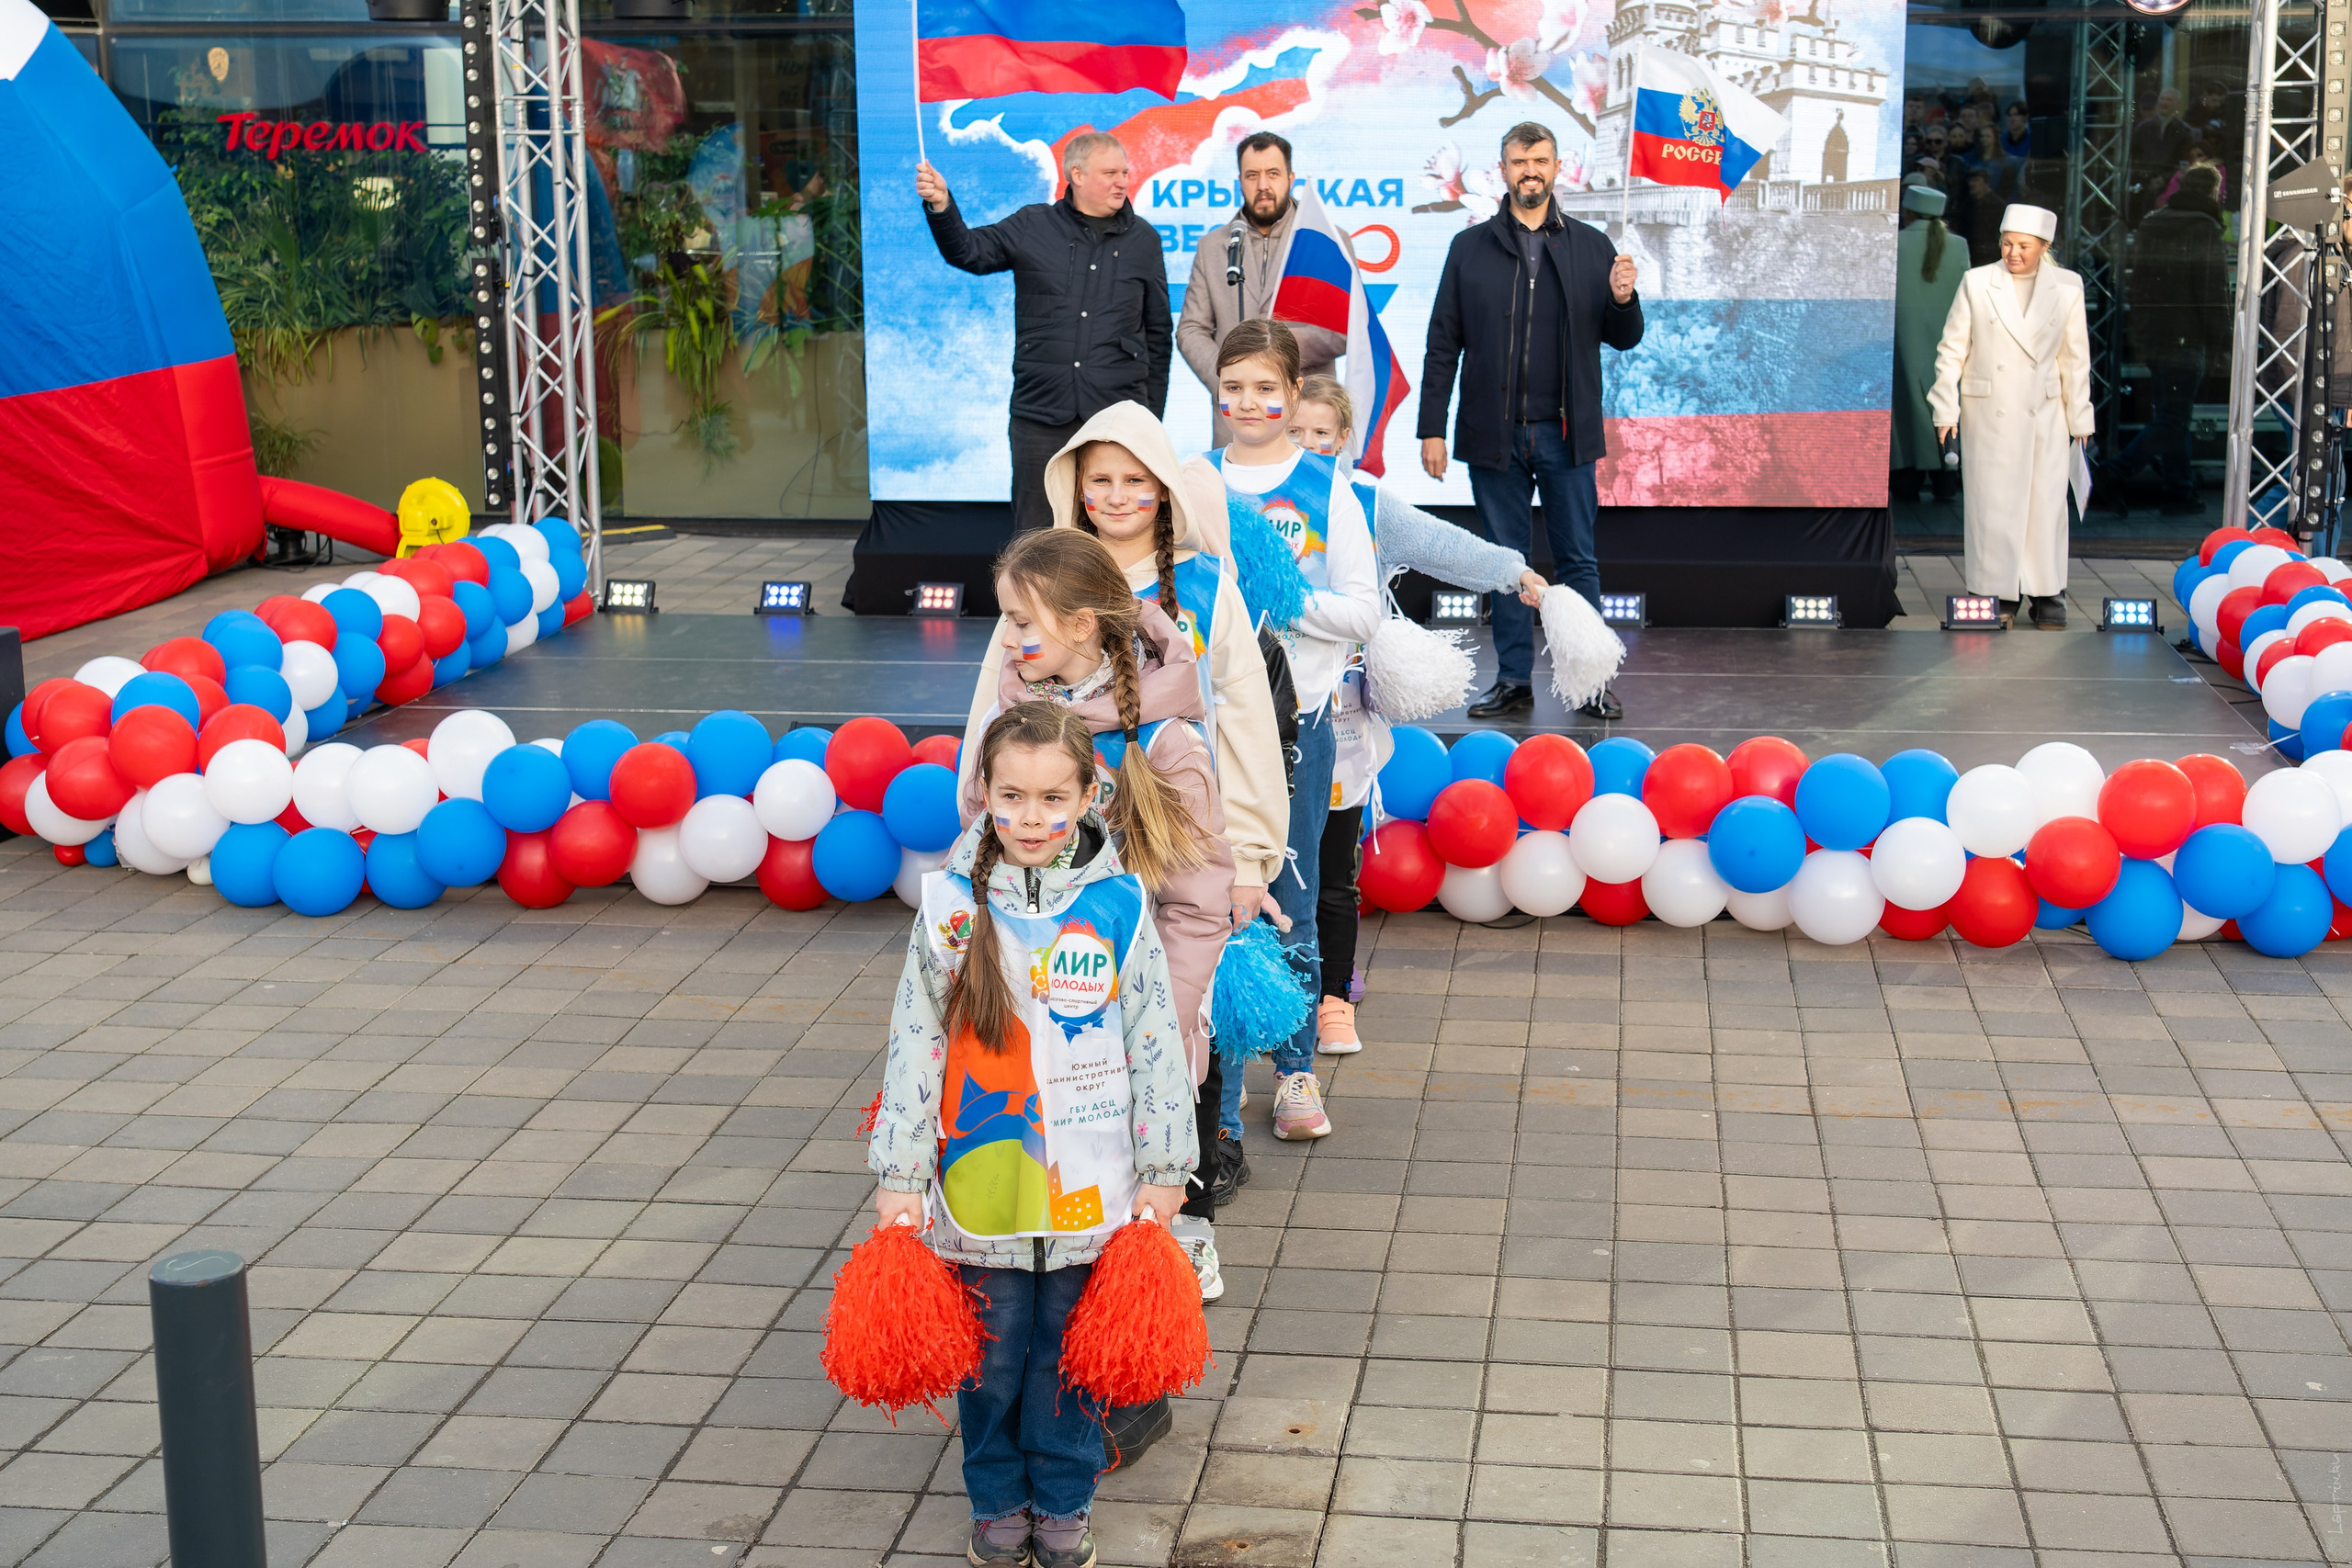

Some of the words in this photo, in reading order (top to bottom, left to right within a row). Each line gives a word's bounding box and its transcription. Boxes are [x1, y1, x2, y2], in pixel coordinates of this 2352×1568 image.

[216, 111, 429, 161] Теремок
[1661, 143, 1723, 166] РОСС
[1151, 177, 1404, 209] КРЫСКАЯ
[1268, 519, 1302, 538] ИР
[1051, 978, 1105, 993] ОЛОДЫХ
[1071, 1057, 1108, 1071] Южный
[1046, 1066, 1126, 1085] дминистративн
[1076, 1081, 1106, 1092] округ
[1069, 1105, 1087, 1115] ГБУ
[1091, 1100, 1116, 1111] ДСЦ
